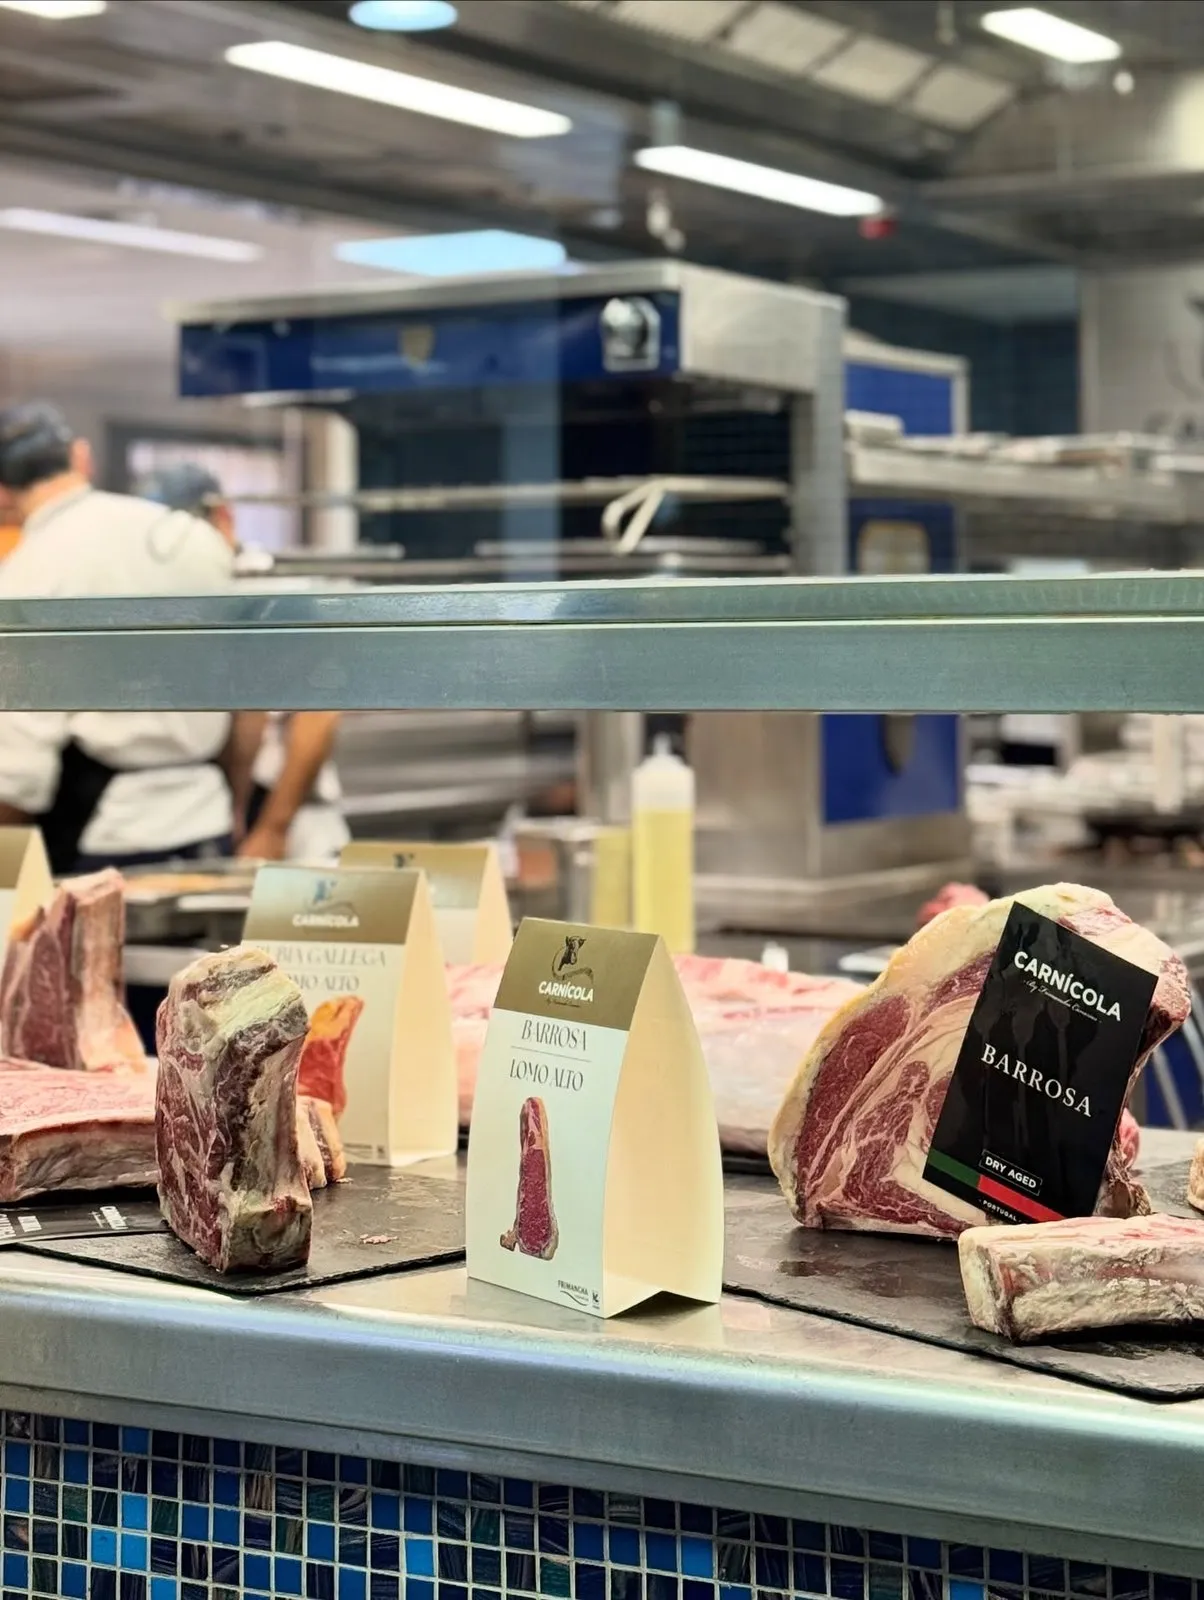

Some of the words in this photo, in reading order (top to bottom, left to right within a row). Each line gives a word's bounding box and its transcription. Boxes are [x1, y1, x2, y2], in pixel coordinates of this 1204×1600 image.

[307, 947, 386, 968] GALLEGA
[322, 975, 360, 991] ALTO
[538, 980, 594, 1002] CARNÍCOLA
[1014, 951, 1121, 1022] CARNÍCOLA
[521, 1019, 587, 1051] BARROSA
[509, 1058, 549, 1084] LOMO
[549, 1067, 584, 1091] ALTO
[981, 1044, 1092, 1117] BARROSA
[985, 1156, 1007, 1173] DRY
[1007, 1169, 1037, 1188] AGED
[982, 1200, 1017, 1222] PORTUGAL
